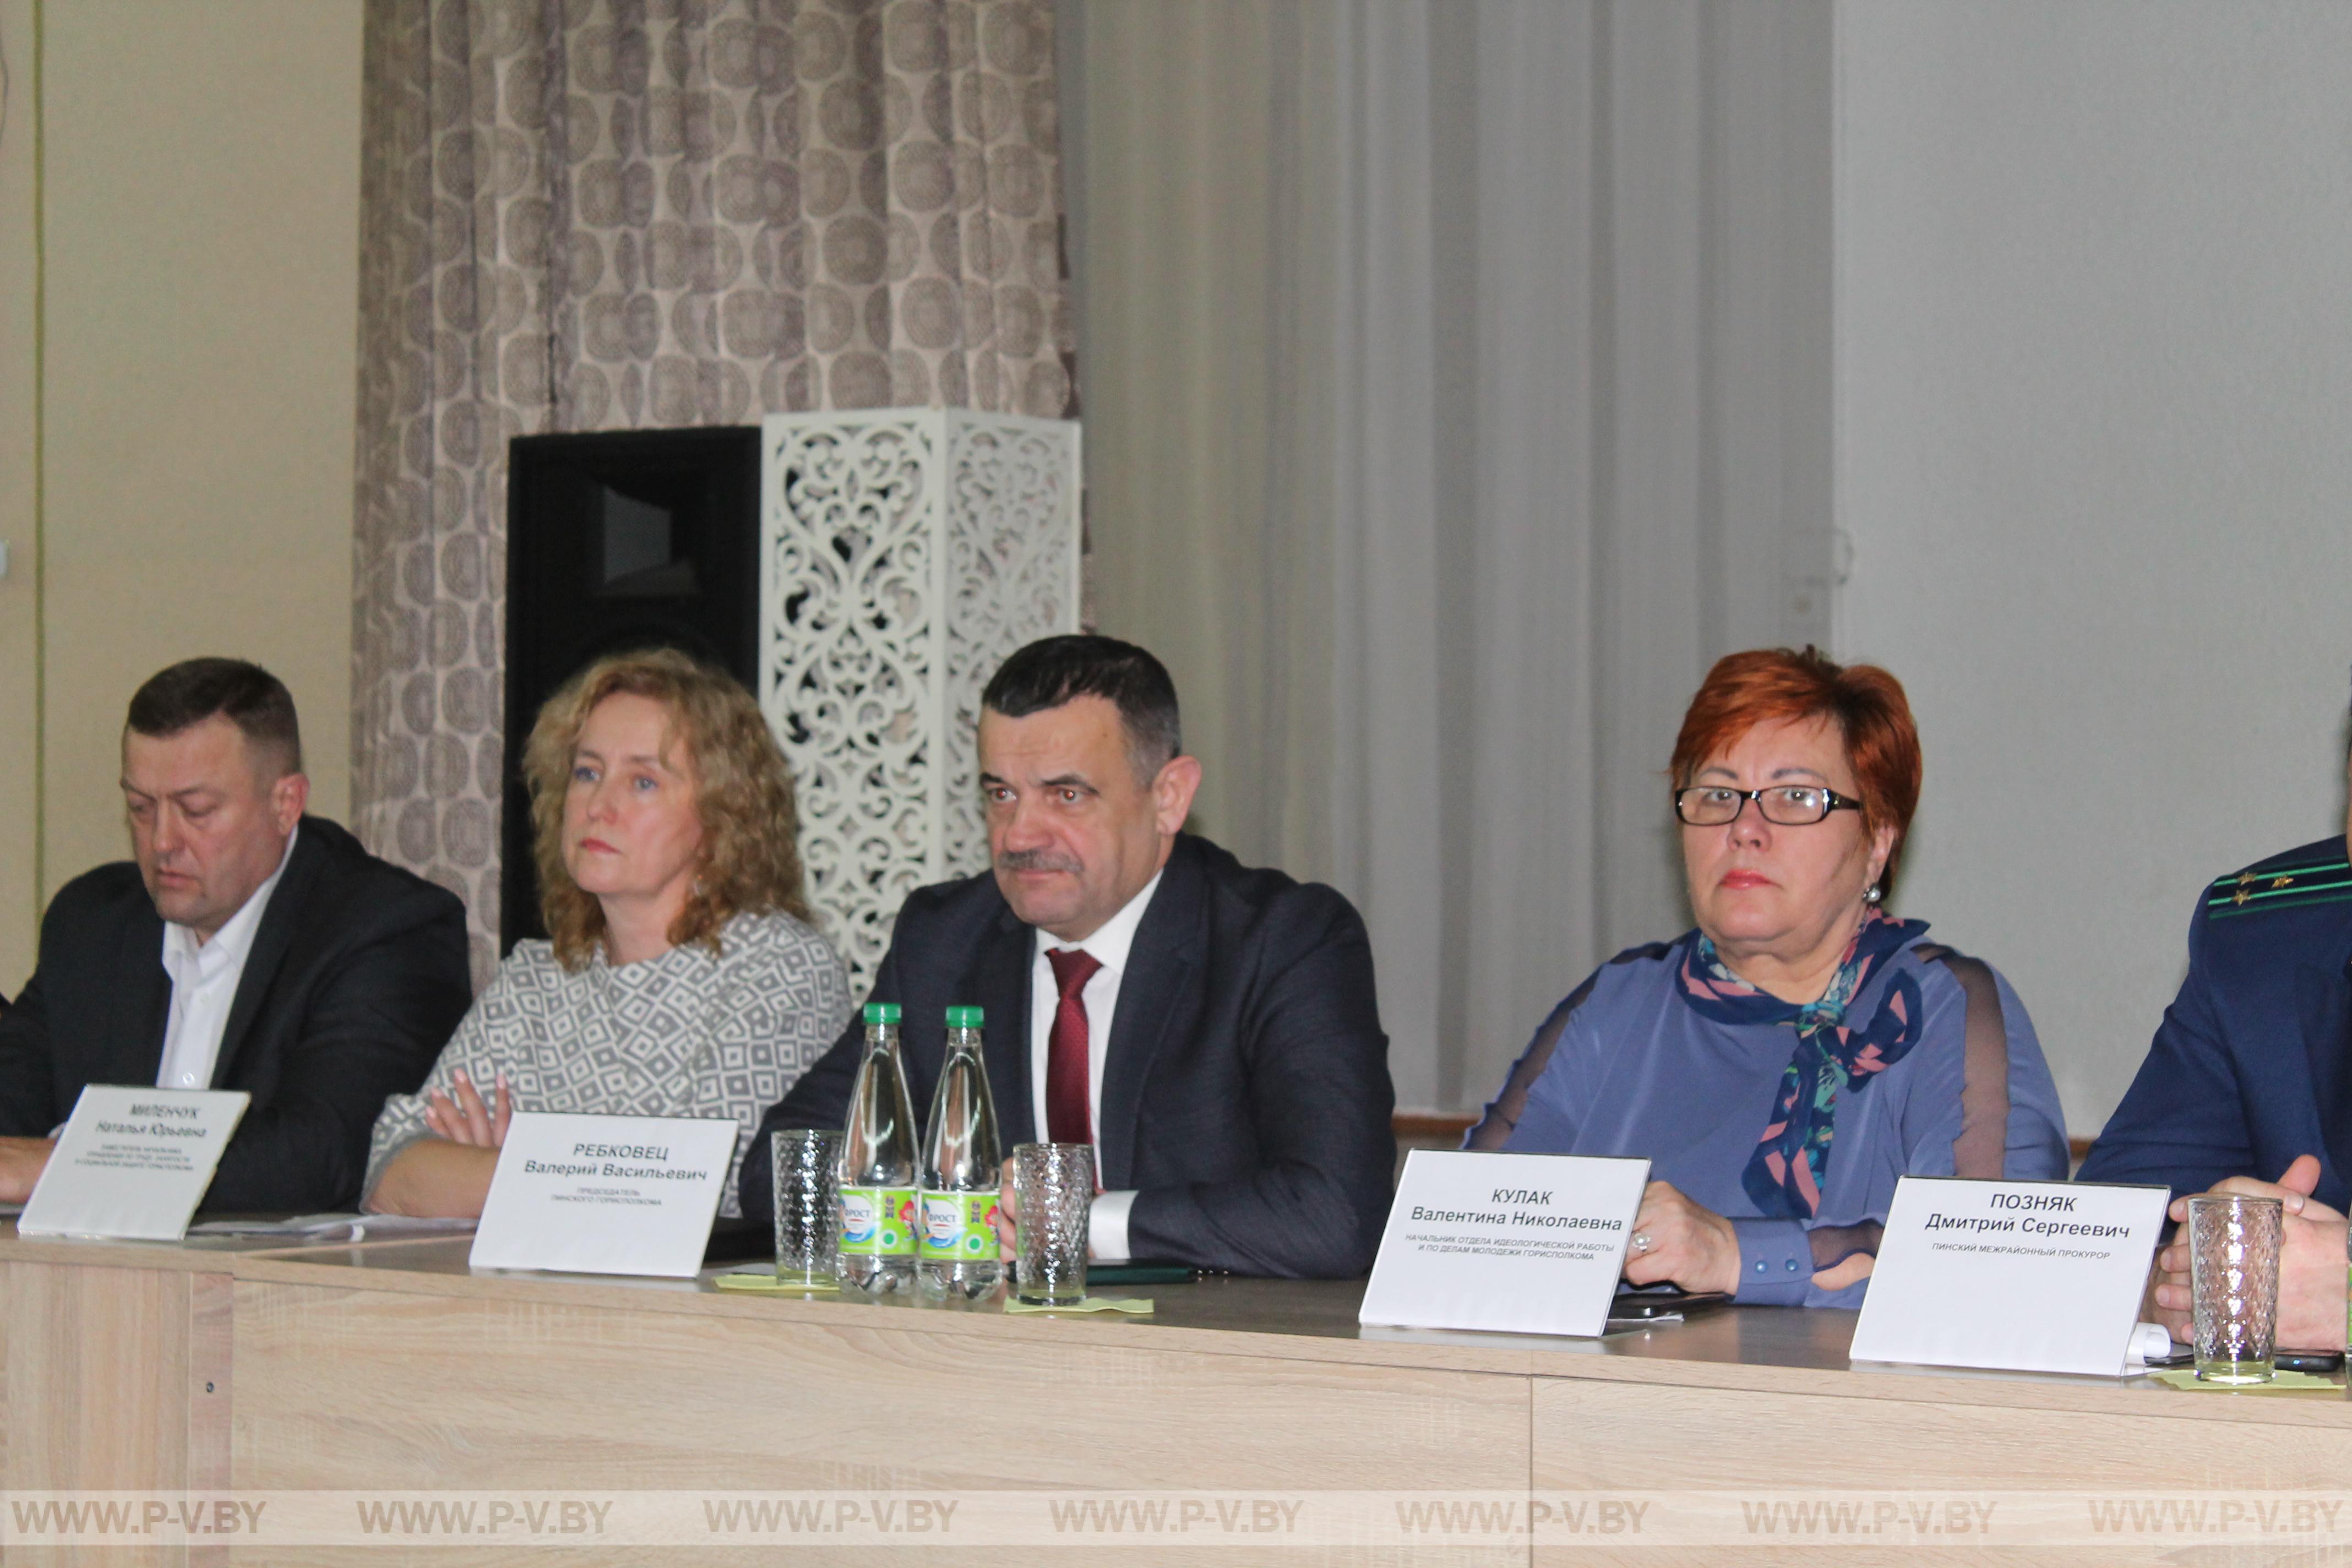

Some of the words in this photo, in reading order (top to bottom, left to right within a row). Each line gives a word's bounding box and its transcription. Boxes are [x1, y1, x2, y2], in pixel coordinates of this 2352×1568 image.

[574, 1144, 668, 1161] РЕБКОВЕЦ
[525, 1160, 597, 1177] Валерий
[602, 1163, 708, 1180] Васильевич
[1492, 1189, 1553, 1205] КУЛАК
[1991, 1194, 2077, 1211] ПОЗНЯК
[1411, 1206, 1506, 1225] Валентина
[1512, 1211, 1623, 1231] Николаевна
[1925, 1214, 2015, 1232] Дмитрий
[2022, 1218, 2130, 1238] Сергеевич
[1406, 1234, 1456, 1243] НАЧАЛЬНИК
[1458, 1237, 1491, 1246] ОТДЕЛА
[1494, 1238, 1575, 1250] ИДЕОЛОГИЧЕСКОЙ
[1577, 1243, 1614, 1251] РАБОТЫ
[1932, 1242, 1977, 1253] ПИНСКИЙ
[1979, 1244, 2056, 1257] МЕЖРАЙОННЫЙ
[2057, 1249, 2110, 1260] ПРОКУРОР
[1440, 1245, 1470, 1254] ДЕЛАМ
[1472, 1247, 1521, 1256] МОЛОДЕЖИ
[1523, 1250, 1594, 1260] ГОРИСПОЛКОМА
